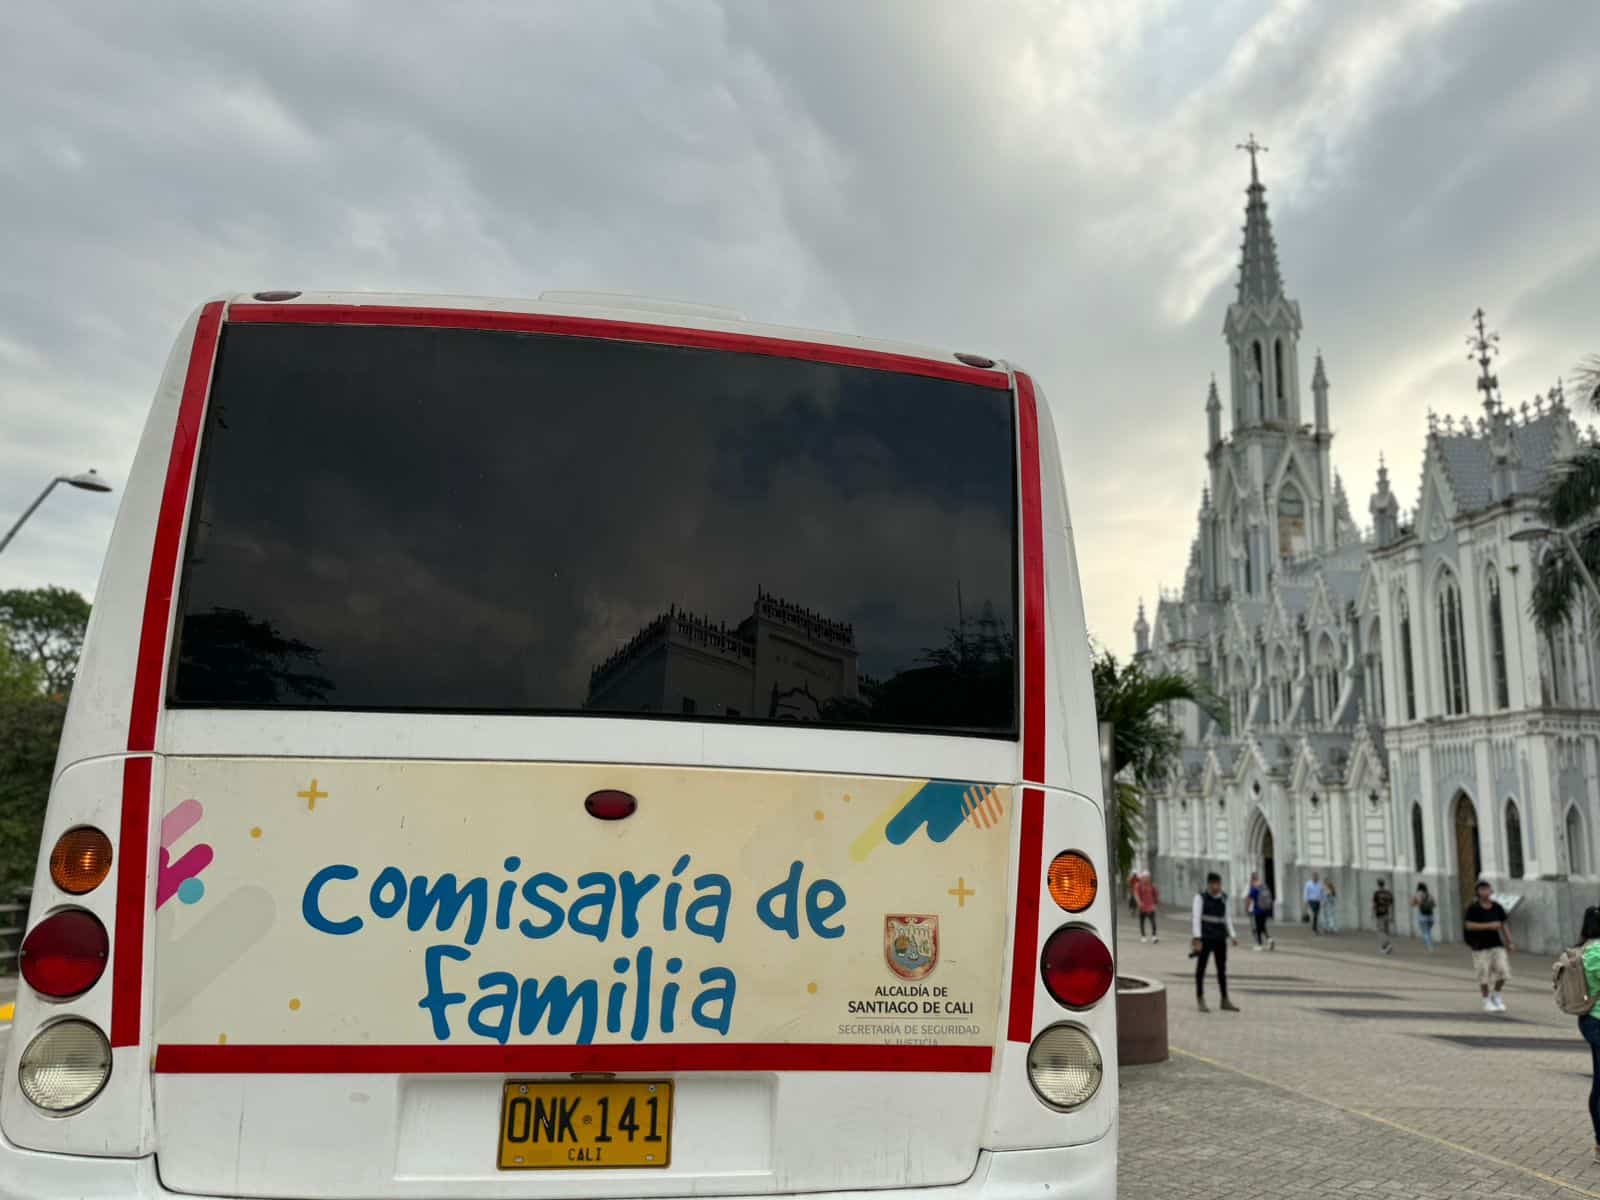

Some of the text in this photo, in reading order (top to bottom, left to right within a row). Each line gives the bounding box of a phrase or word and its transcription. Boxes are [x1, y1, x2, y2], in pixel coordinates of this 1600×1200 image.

[757, 860, 847, 939] de
[874, 984, 949, 997] ALCALDÍA DE
[848, 1001, 973, 1014] SANTIAGO DE CALI
[904, 1025, 919, 1035] DE
[921, 1025, 980, 1035] SEGURIDAD
[507, 1096, 662, 1143] ONK 141
[567, 1147, 603, 1162] CALI
